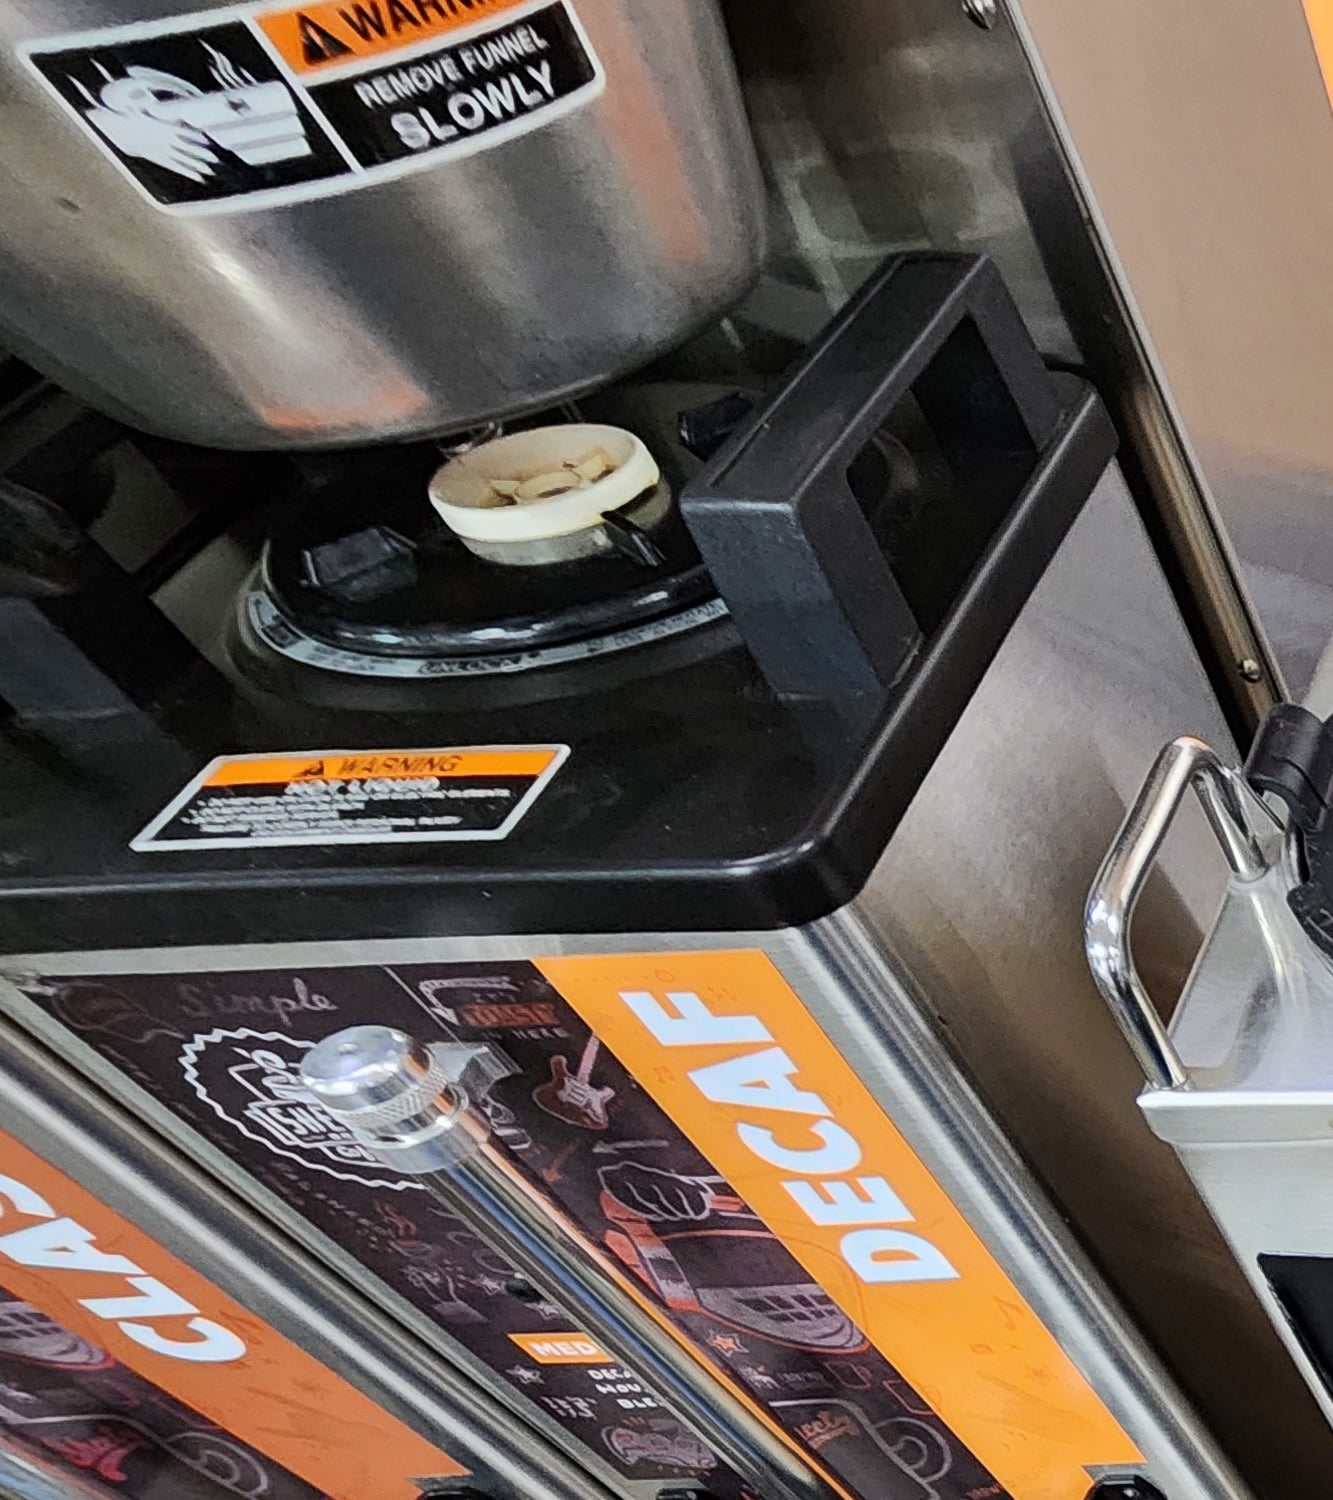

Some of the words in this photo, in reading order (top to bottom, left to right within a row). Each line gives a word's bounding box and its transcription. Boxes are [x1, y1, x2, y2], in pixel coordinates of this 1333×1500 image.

[354, 56, 463, 109] REMOVE
[460, 24, 550, 75] FUNNEL
[390, 59, 556, 150] SLOWLY
[339, 755, 463, 773] WARNING
[618, 991, 962, 1283] DECAF
[596, 1383, 646, 1394] HOU
